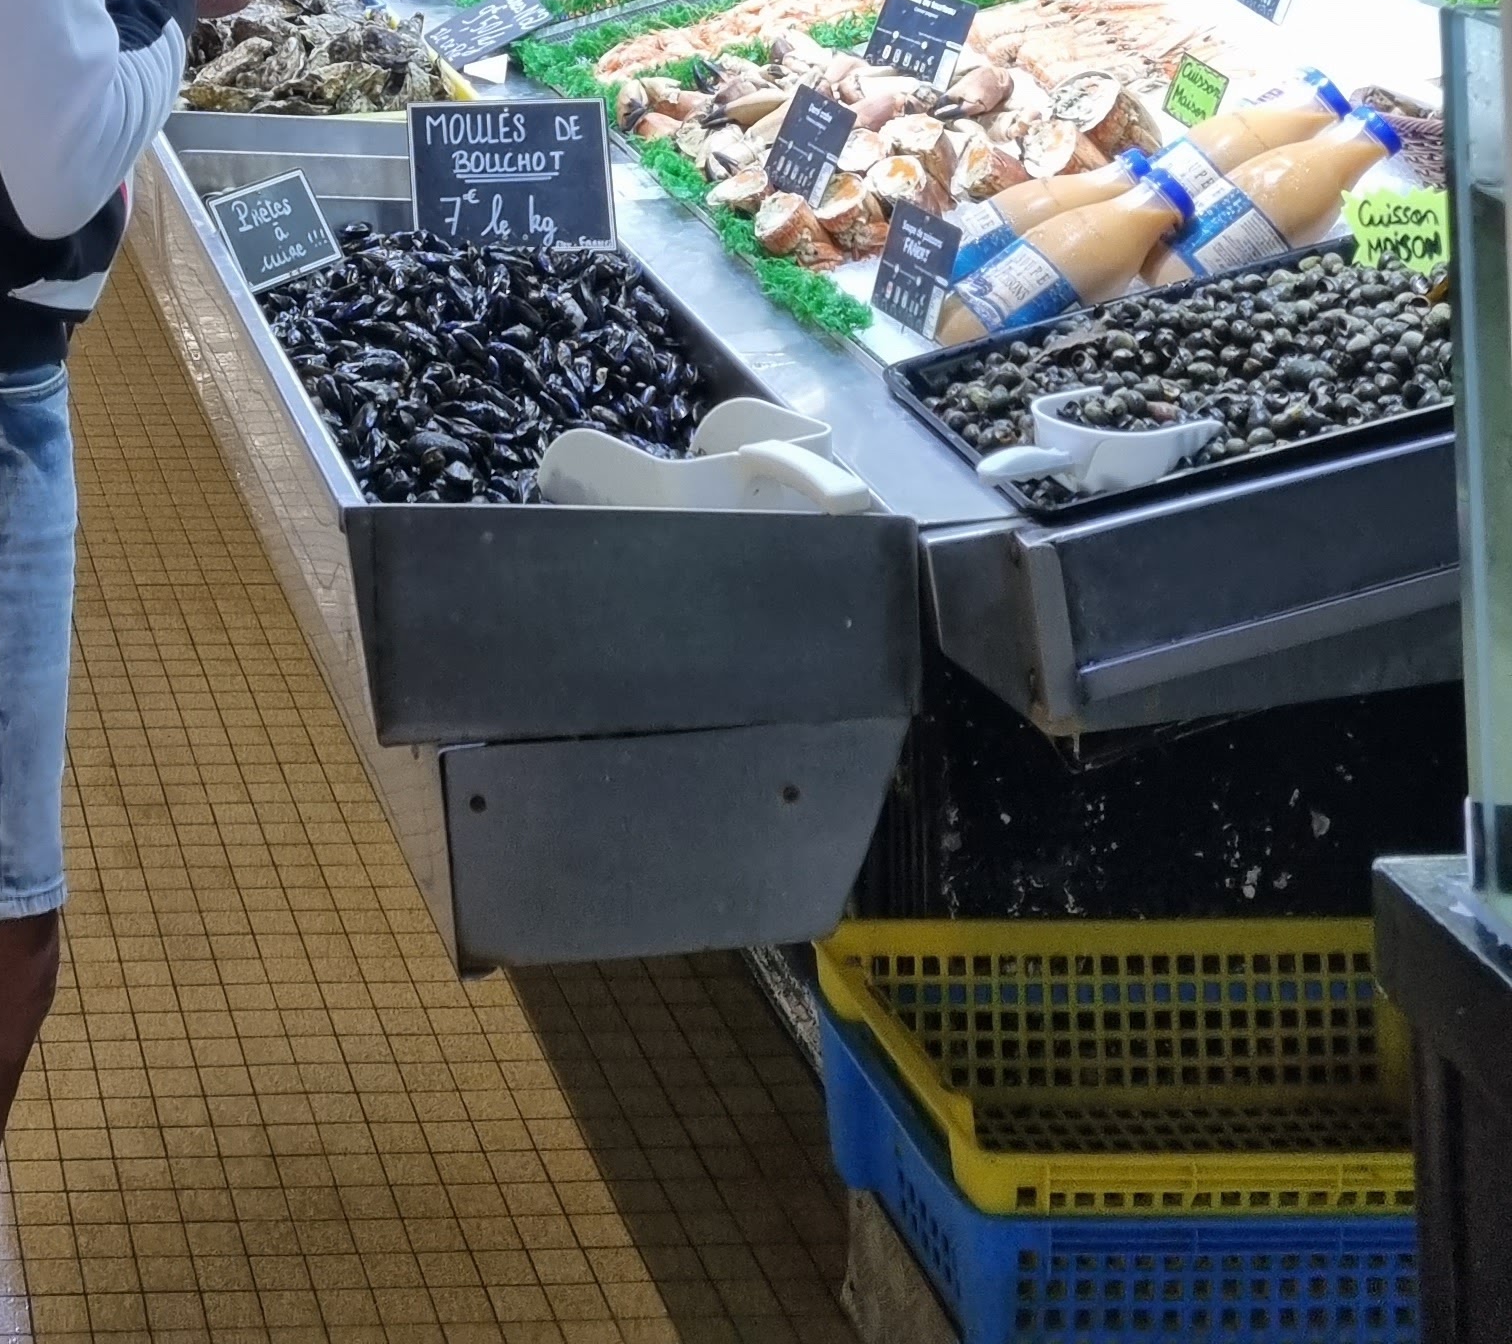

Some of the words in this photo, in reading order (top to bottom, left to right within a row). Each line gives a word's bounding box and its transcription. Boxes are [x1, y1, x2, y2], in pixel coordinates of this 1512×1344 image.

[1181, 62, 1223, 100] Cuisson
[1172, 84, 1207, 121] Maison
[426, 112, 526, 145] MOULES
[555, 115, 583, 141] DE
[452, 150, 565, 174] BOUCHOT
[232, 198, 292, 232] Prêtes
[481, 193, 511, 236] le
[529, 195, 557, 246] kg
[1358, 200, 1439, 228] Cuisson
